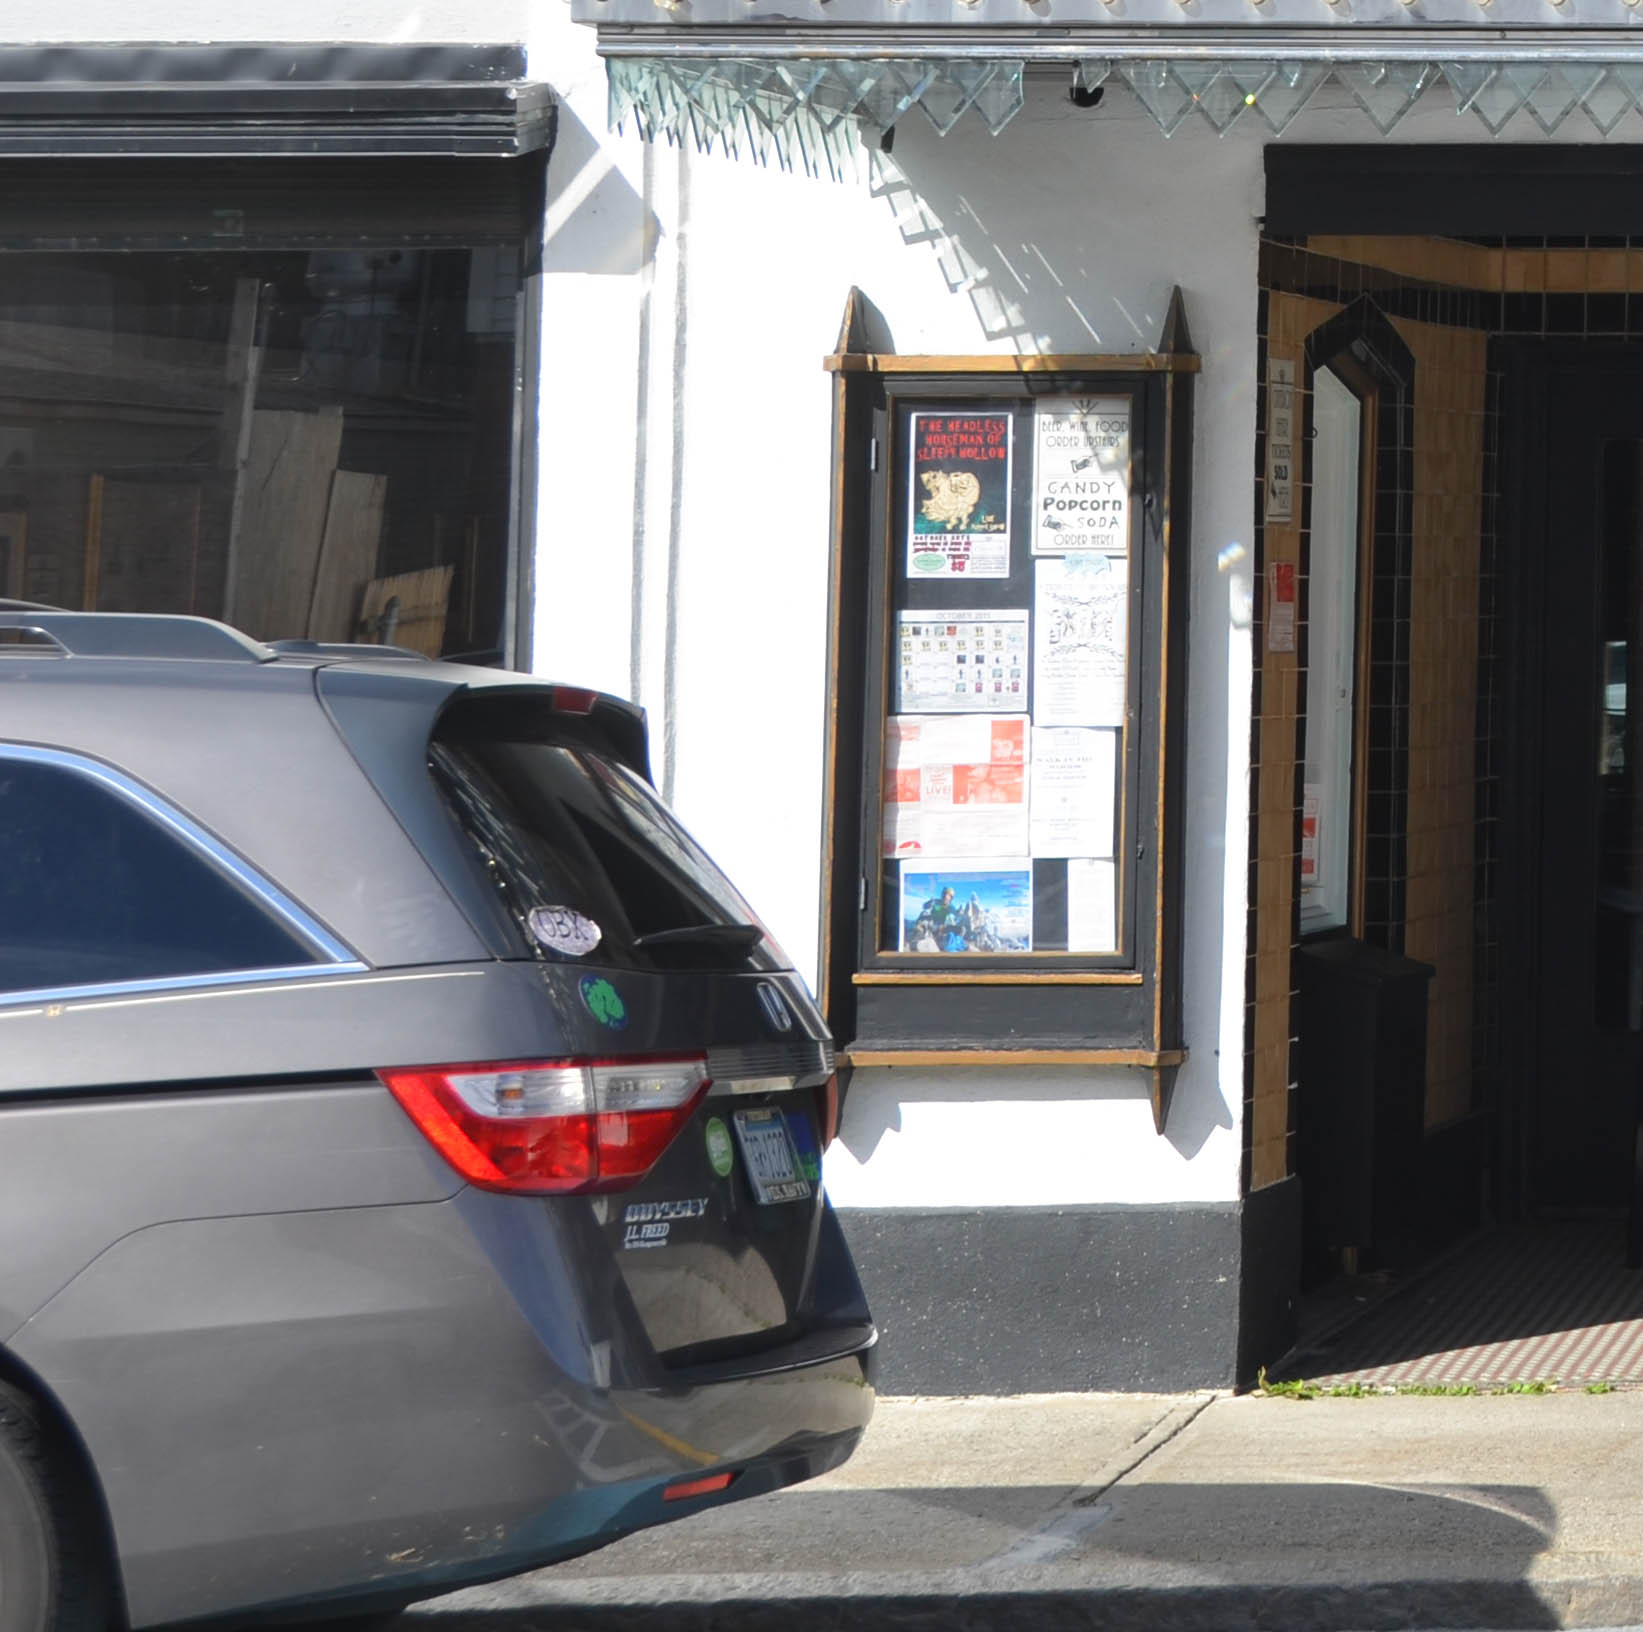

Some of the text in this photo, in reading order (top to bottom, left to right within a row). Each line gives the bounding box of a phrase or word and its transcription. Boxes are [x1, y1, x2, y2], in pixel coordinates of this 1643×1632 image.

[919, 419, 1006, 433] THE HEADLESS
[1095, 420, 1128, 433] FOOD
[926, 432, 1002, 446] HORSEMAN OF
[1046, 436, 1080, 448] ORDER
[916, 447, 1006, 461] SLEEPY HOLLOW
[1047, 480, 1116, 495] CANDY
[1043, 496, 1122, 511] Popcorn
[1078, 516, 1120, 529] SODA
[1054, 534, 1088, 546] ORDER
[624, 1197, 709, 1223] ODYSSEY
[640, 1222, 670, 1239] FREED
